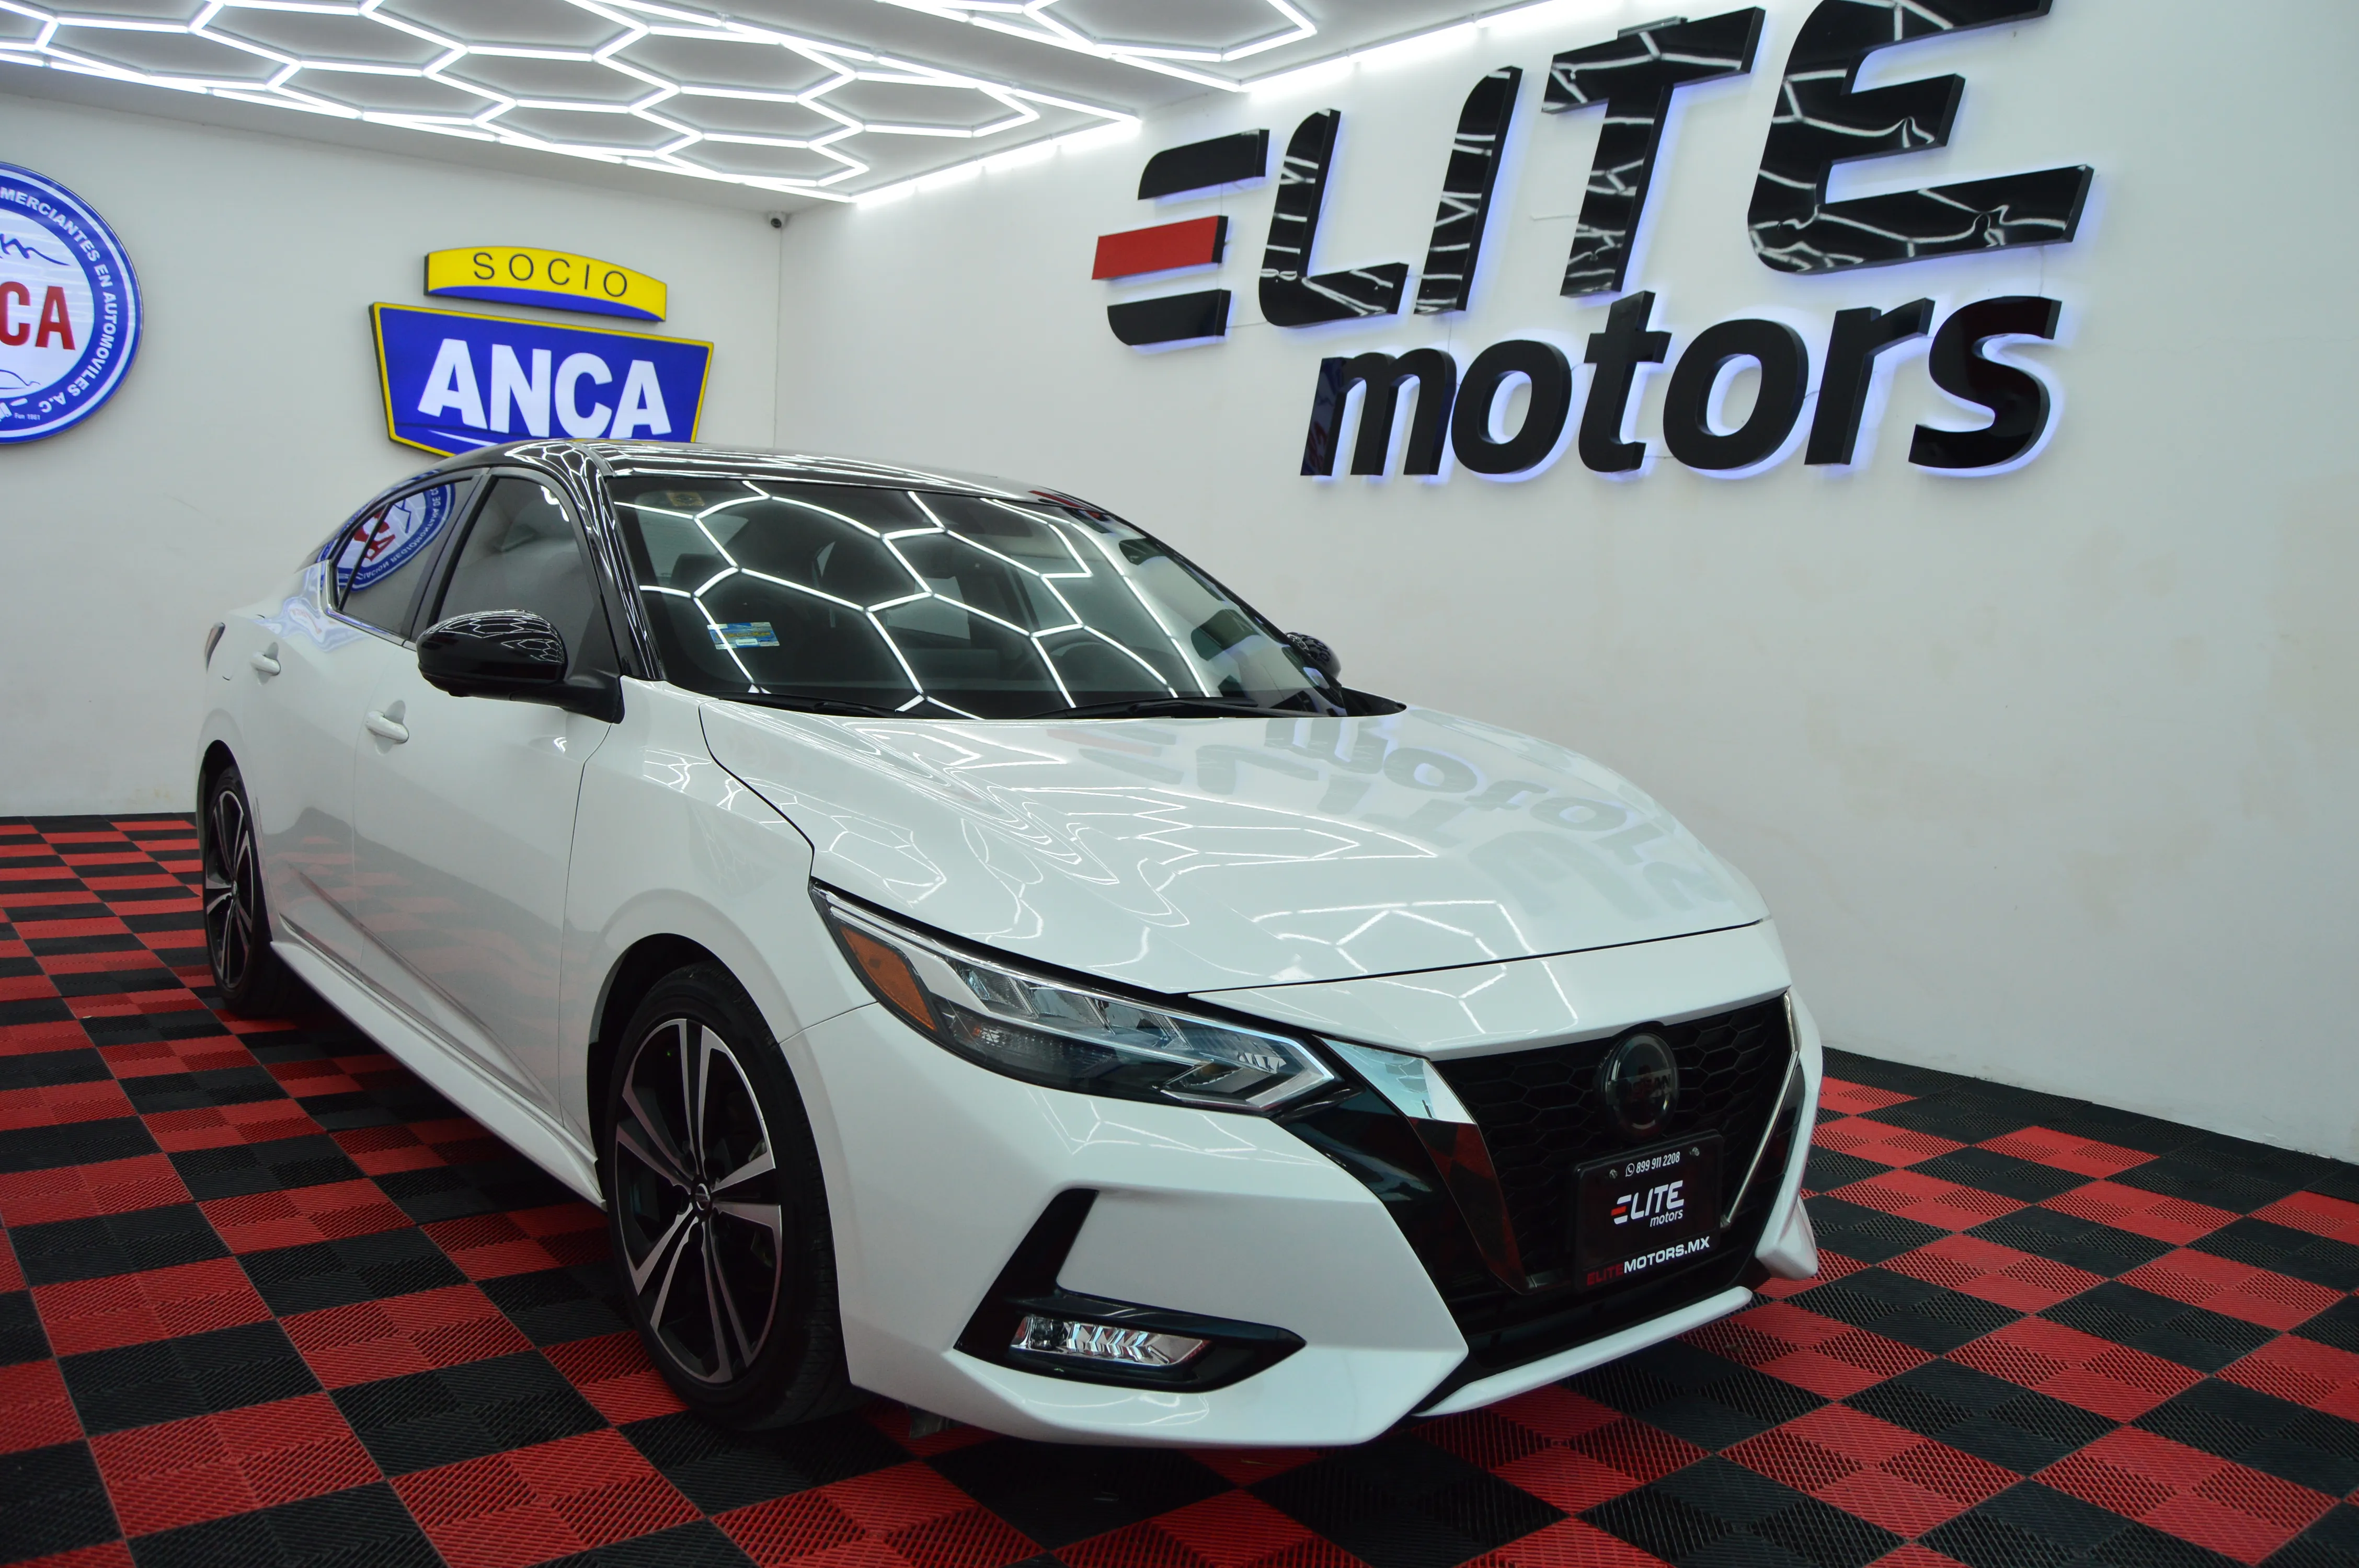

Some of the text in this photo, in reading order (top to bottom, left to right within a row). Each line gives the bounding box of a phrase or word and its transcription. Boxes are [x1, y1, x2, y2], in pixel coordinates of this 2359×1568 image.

[1092, 0, 2093, 345] ELITE
[94, 264, 112, 287] EN
[473, 252, 627, 297] SOCIO
[67, 292, 118, 396] AUTOMOVILES
[418, 338, 672, 439] ANCA
[1300, 291, 2063, 477] motors
[1636, 1151, 1680, 1174] 899 911 2208
[1611, 1180, 1685, 1225] ELITE
[1650, 1209, 1683, 1227] motors
[1587, 1236, 1710, 1286] ELITEMOTORS.MX
